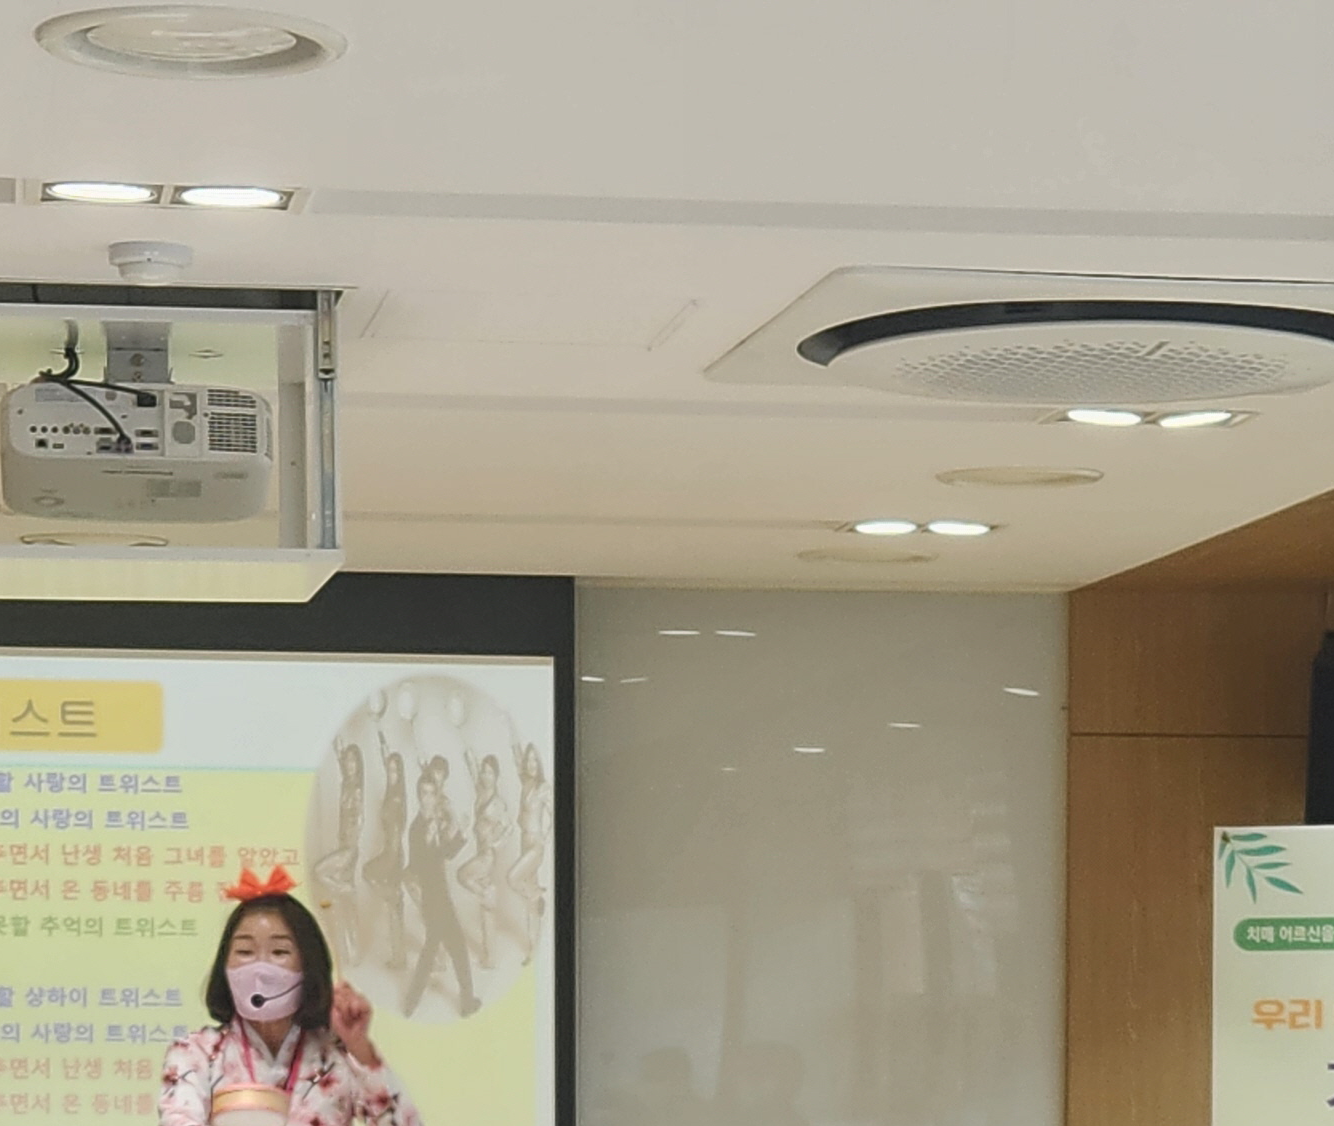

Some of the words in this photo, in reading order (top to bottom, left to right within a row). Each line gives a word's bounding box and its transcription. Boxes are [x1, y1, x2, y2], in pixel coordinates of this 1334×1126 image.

[24, 772, 88, 794] 사랑의
[98, 773, 183, 795] 트위스트
[30, 808, 93, 830] 사랑의
[105, 810, 189, 831] 트위스트
[62, 843, 102, 866] 난생
[113, 844, 153, 866] 처음
[164, 845, 226, 867] 그녀를
[62, 880, 81, 902] 온
[91, 880, 153, 902] 동네를
[165, 881, 204, 903] 주름
[40, 916, 104, 937] 추억의
[114, 917, 199, 937] 트위스트
[1247, 925, 1274, 943] 치매
[1279, 924, 1334, 942] 어르신을
[99, 987, 183, 1008] 트위스트
[1251, 998, 1323, 1030] 우리
[32, 1023, 94, 1044] 사랑의
[105, 1024, 188, 1045] 트위스트
[62, 1058, 103, 1080] 난생
[113, 1058, 152, 1080] 처음
[91, 1093, 156, 1115] 동네를
